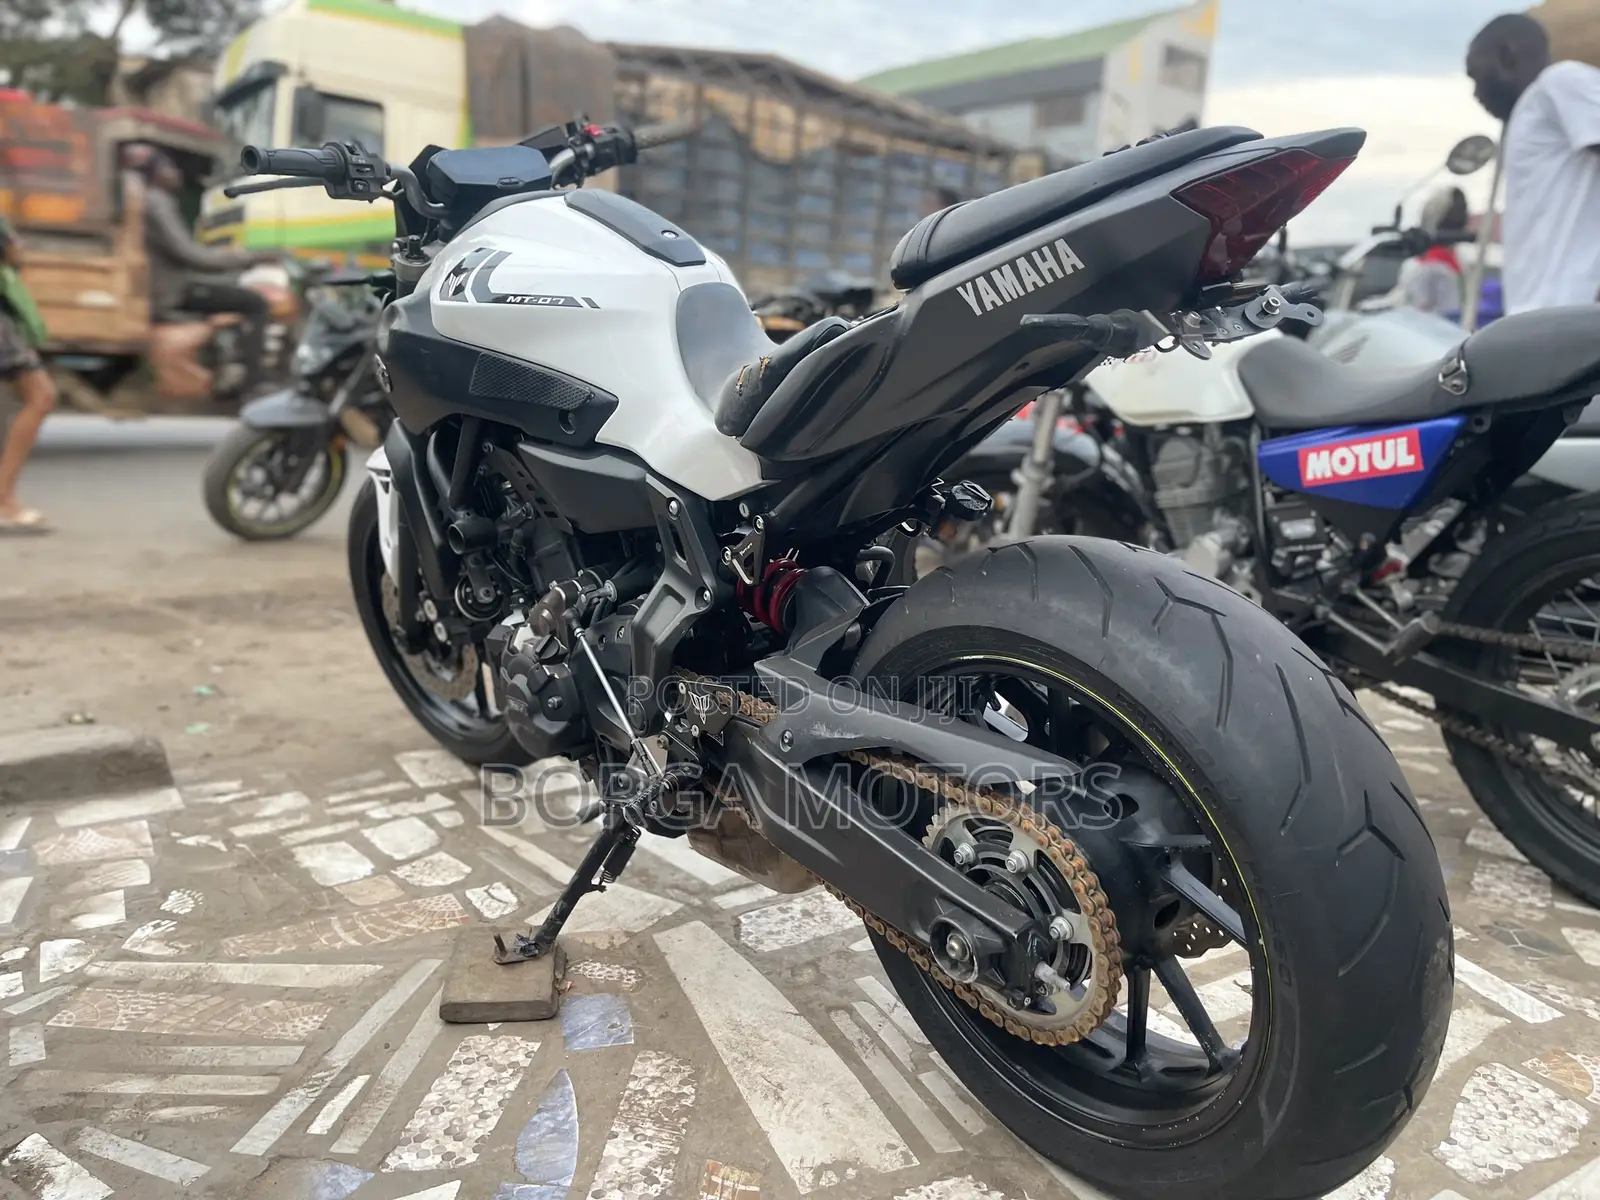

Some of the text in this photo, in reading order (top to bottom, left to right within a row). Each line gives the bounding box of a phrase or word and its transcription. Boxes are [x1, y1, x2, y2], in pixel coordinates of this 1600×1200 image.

[956, 238, 1086, 316] YAMAHA
[506, 295, 565, 305] MT-07
[1305, 436, 1415, 481] MOTUL
